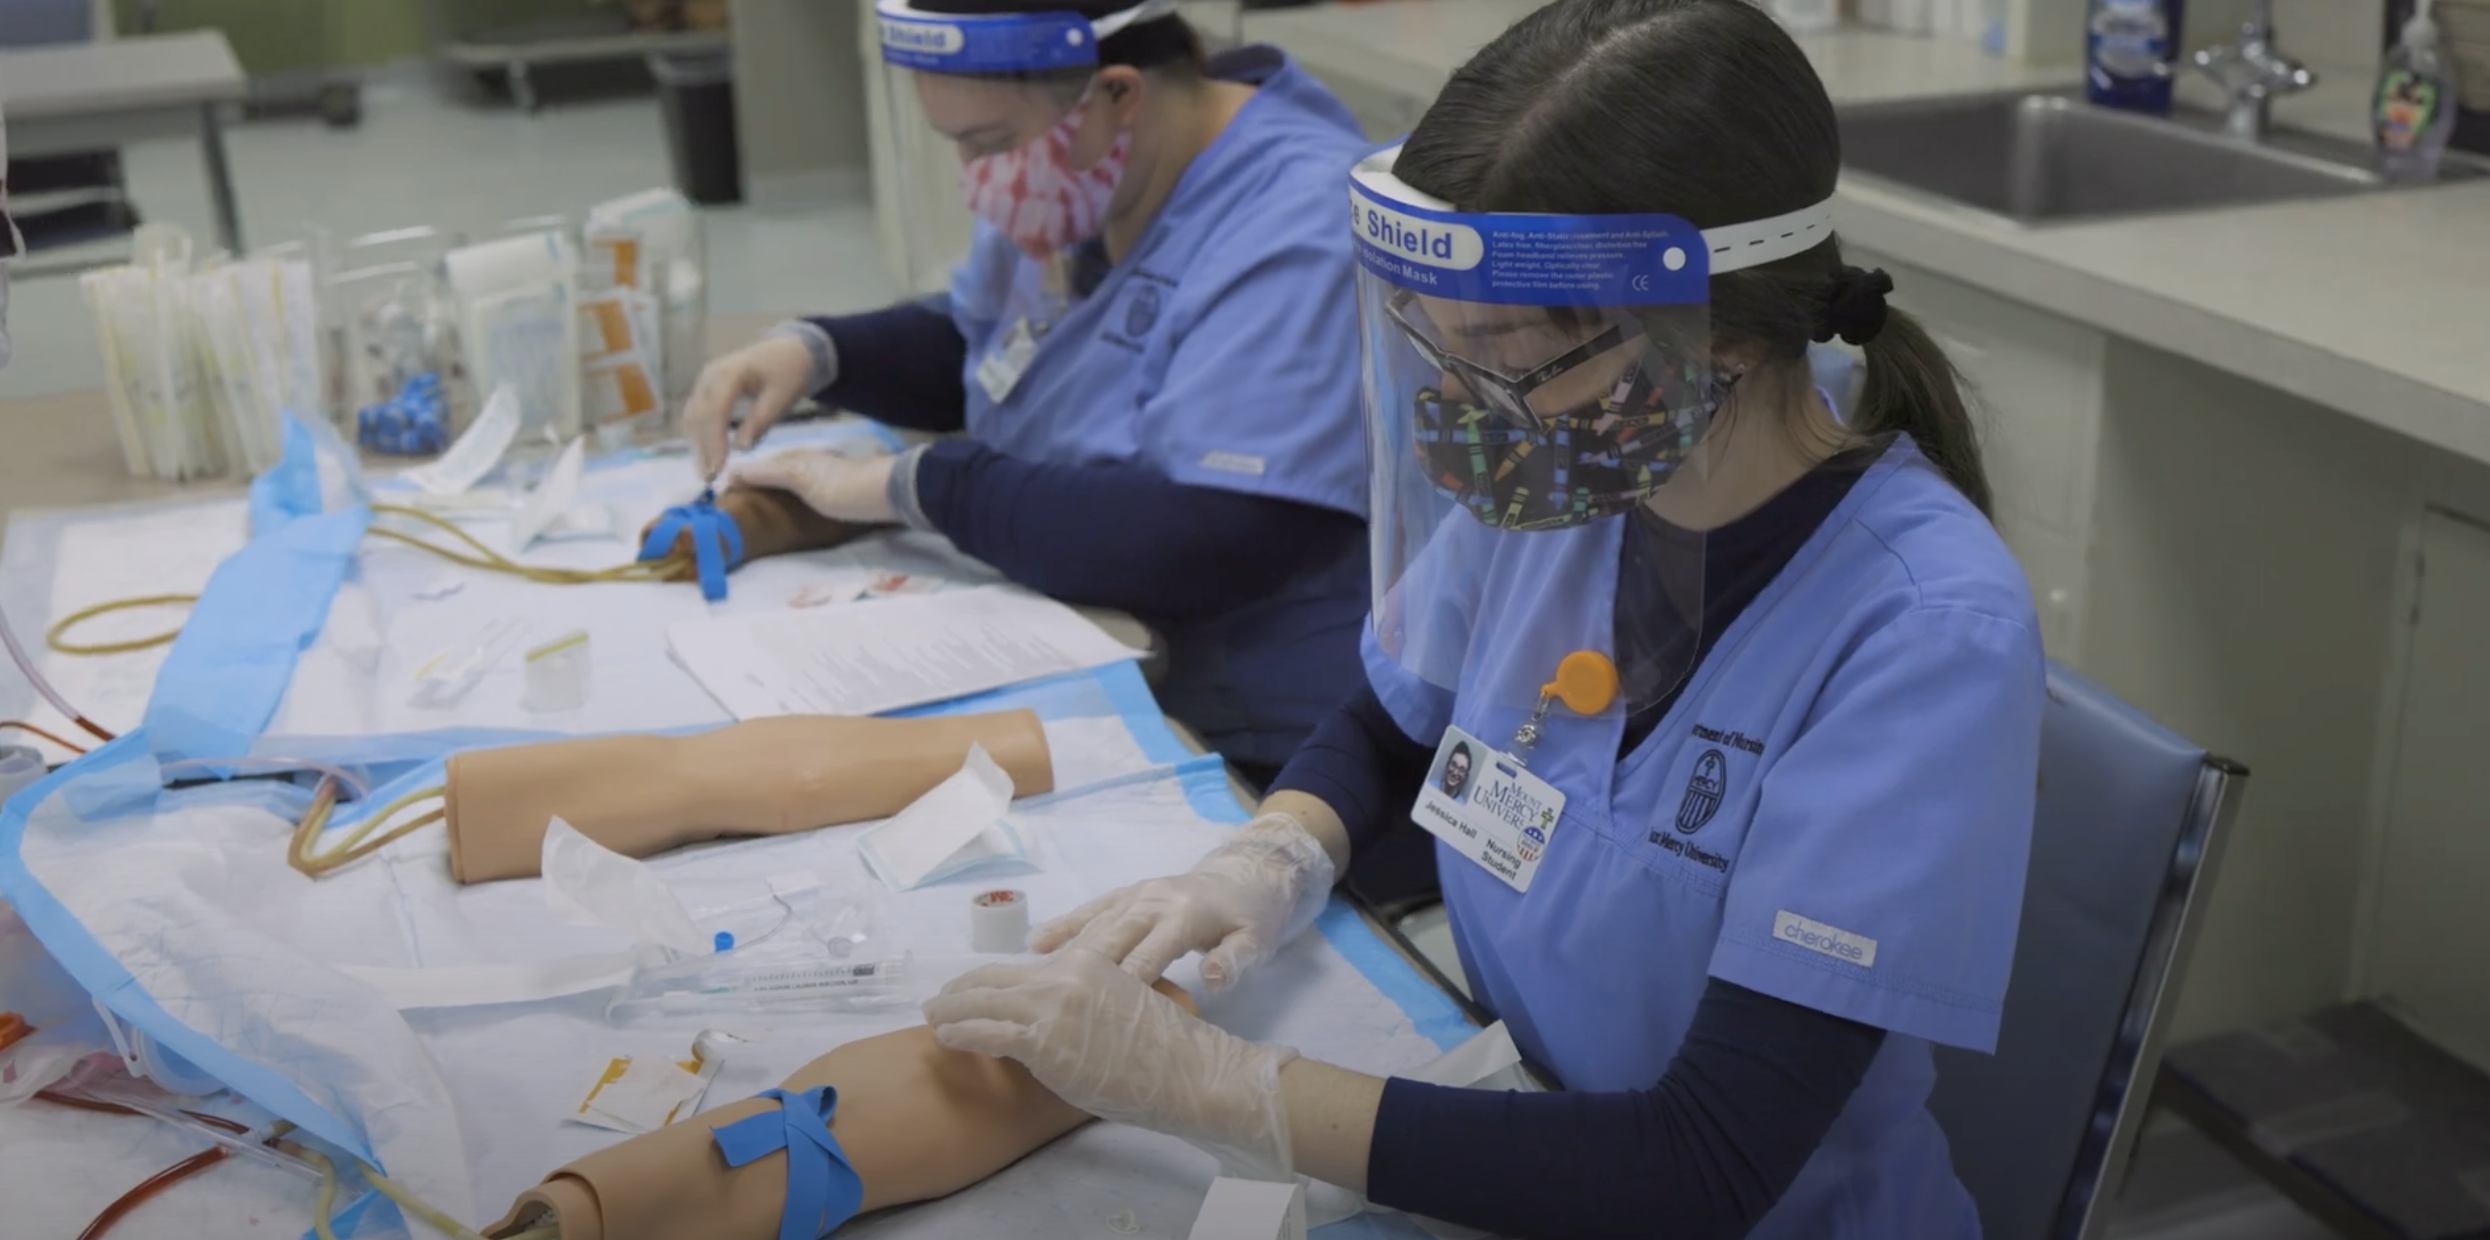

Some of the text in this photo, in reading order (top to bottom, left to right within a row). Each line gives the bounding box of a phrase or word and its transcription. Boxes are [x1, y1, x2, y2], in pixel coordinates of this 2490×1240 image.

[1367, 208, 1452, 259] Shield
[1492, 241, 1514, 249] Latex
[1492, 260, 1513, 269] Light
[1544, 261, 1580, 270] Optically
[1516, 251, 1556, 259] headband
[1402, 264, 1438, 285] Mask
[1492, 270, 1518, 278] Please
[1520, 271, 1550, 279] remove
[1551, 271, 1563, 279] the
[1492, 280, 1531, 288] protective
[1533, 280, 1548, 288] film
[1549, 281, 1575, 289] before
[1489, 780, 1540, 824] MERCY
[1508, 781, 1543, 811] MOUNT
[1424, 799, 1478, 840] Jessica Hall
[1480, 851, 1518, 881] Student
[1485, 837, 1523, 870] Nursing
[1684, 840, 1730, 874] University
[1784, 920, 1863, 960] cherokee
